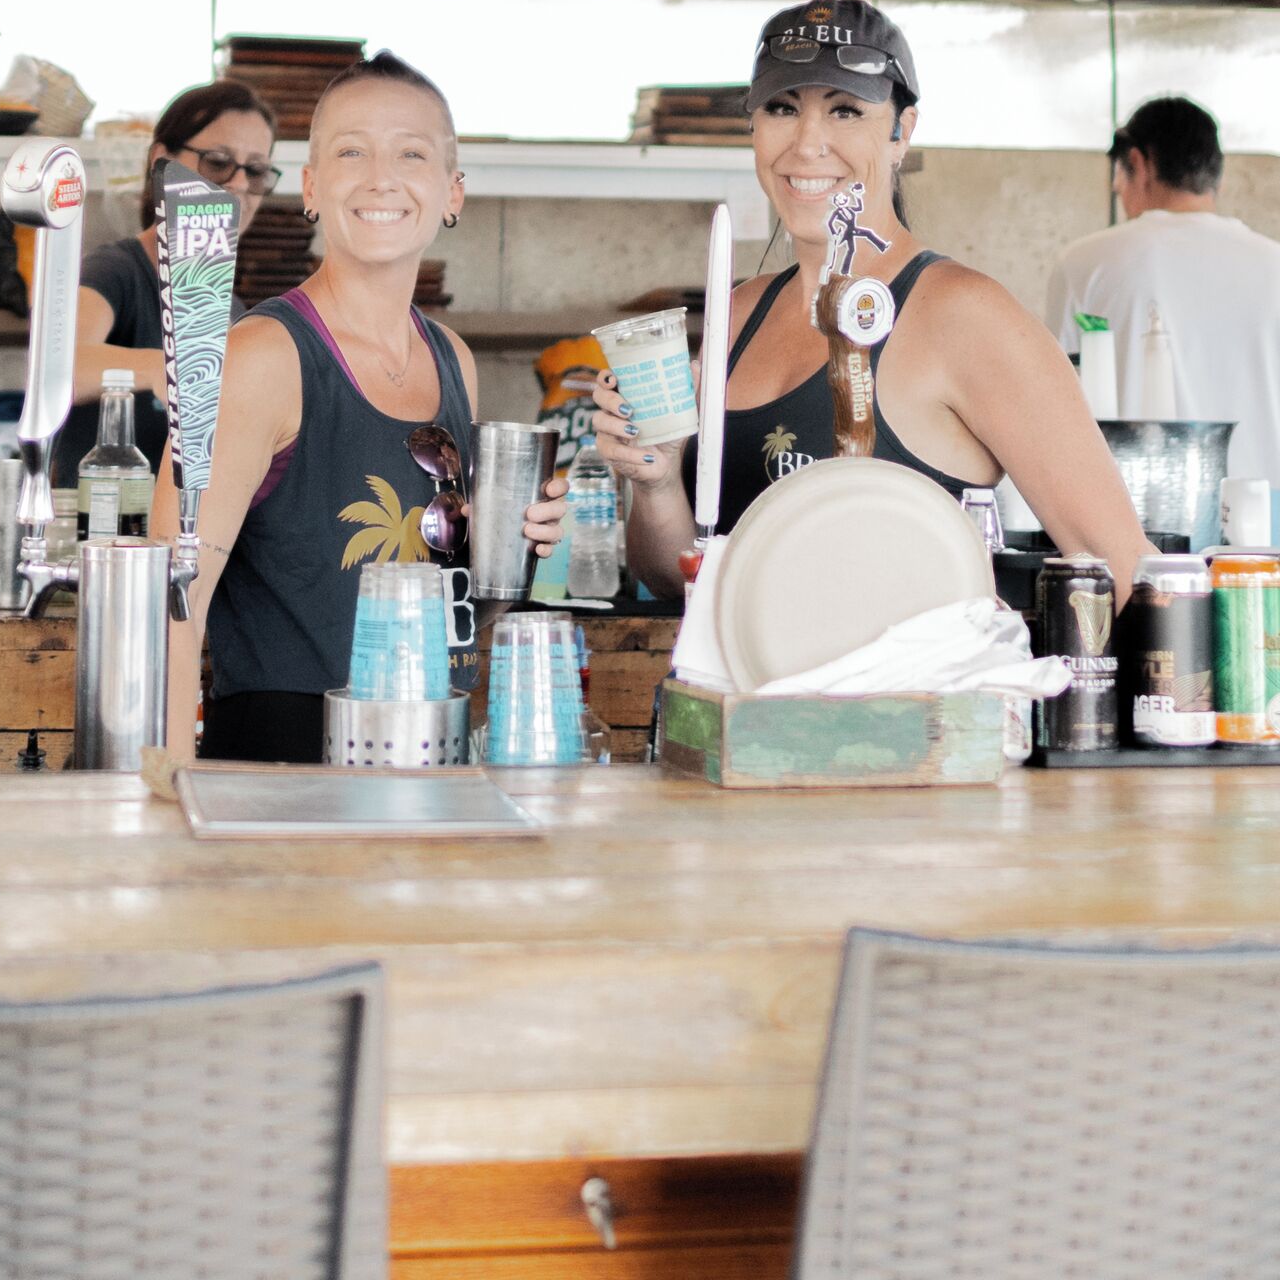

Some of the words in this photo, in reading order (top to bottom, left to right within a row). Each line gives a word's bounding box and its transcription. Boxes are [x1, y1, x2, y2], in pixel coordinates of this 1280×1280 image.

[59, 181, 81, 194] STELLA
[58, 191, 81, 203] ARTOIS
[177, 203, 233, 216] DRAGON
[177, 214, 233, 230] POINT
[176, 227, 232, 257] IPA
[154, 199, 183, 466] INTRACOASTAL
[848, 352, 867, 422] CROOKED
[1060, 654, 1119, 672] GUINNESS
